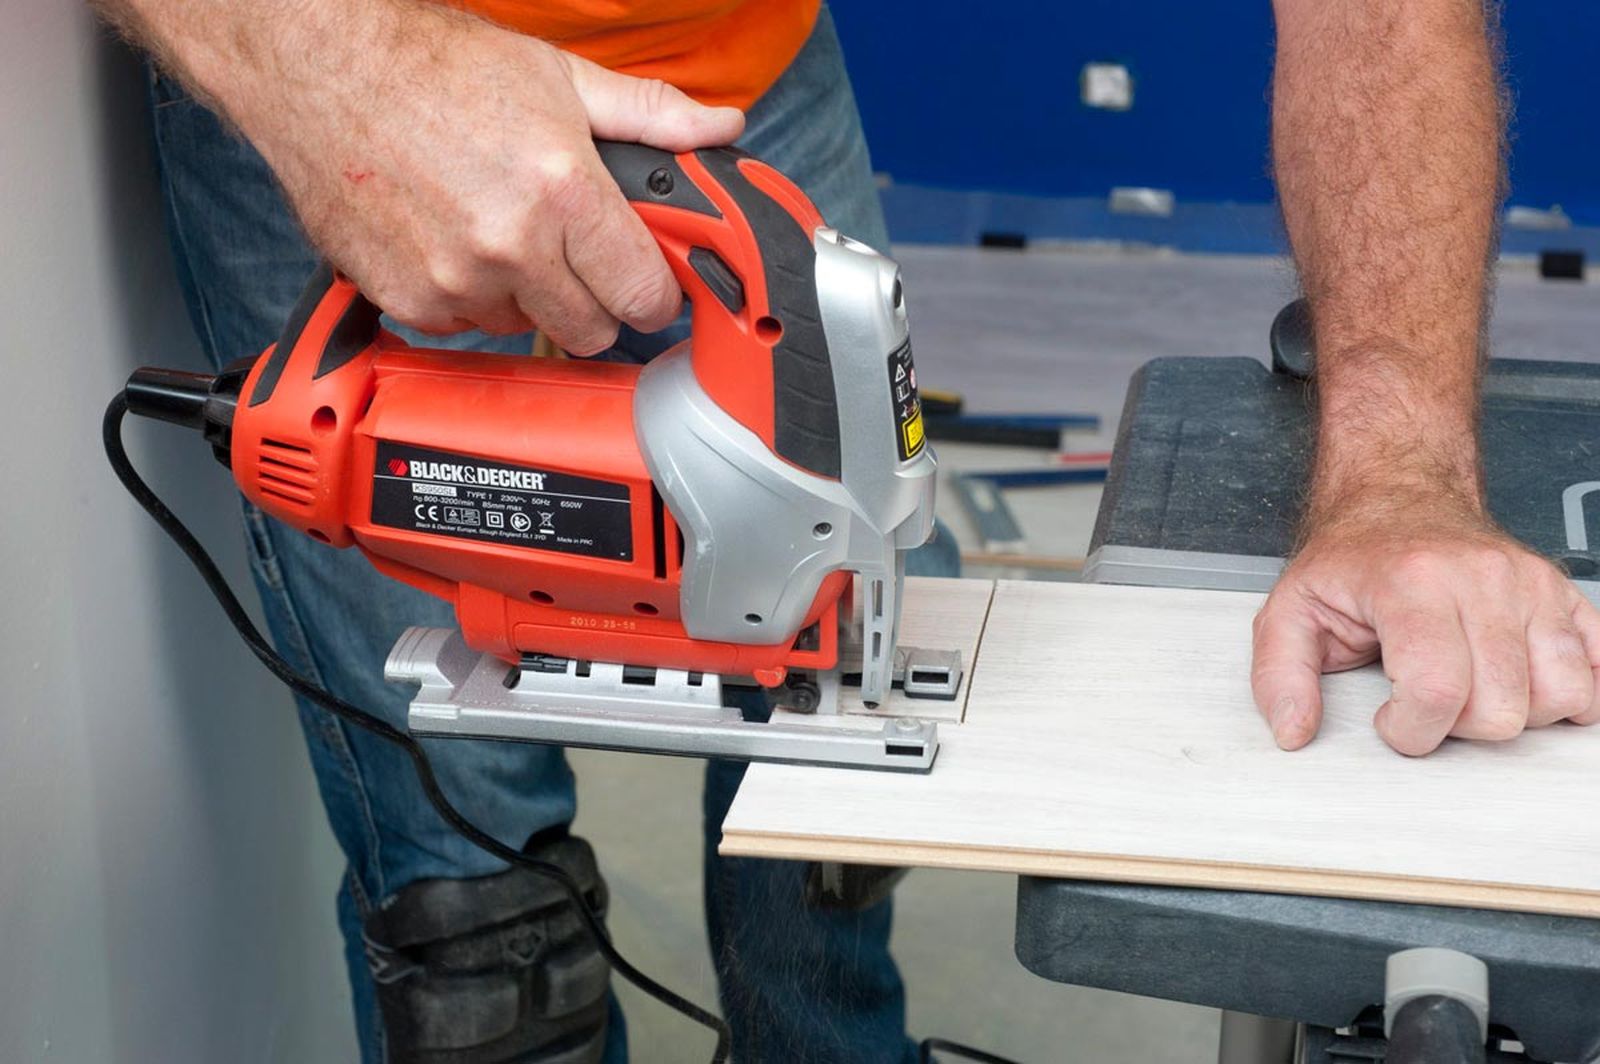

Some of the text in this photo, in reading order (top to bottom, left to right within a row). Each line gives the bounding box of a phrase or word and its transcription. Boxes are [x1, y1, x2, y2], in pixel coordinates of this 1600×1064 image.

[466, 490, 487, 500] TYPE
[531, 497, 550, 506] 50Hz
[560, 500, 583, 509] 650W
[482, 501, 506, 510] 85mm
[556, 536, 572, 544] Made
[570, 616, 597, 627] 2010
